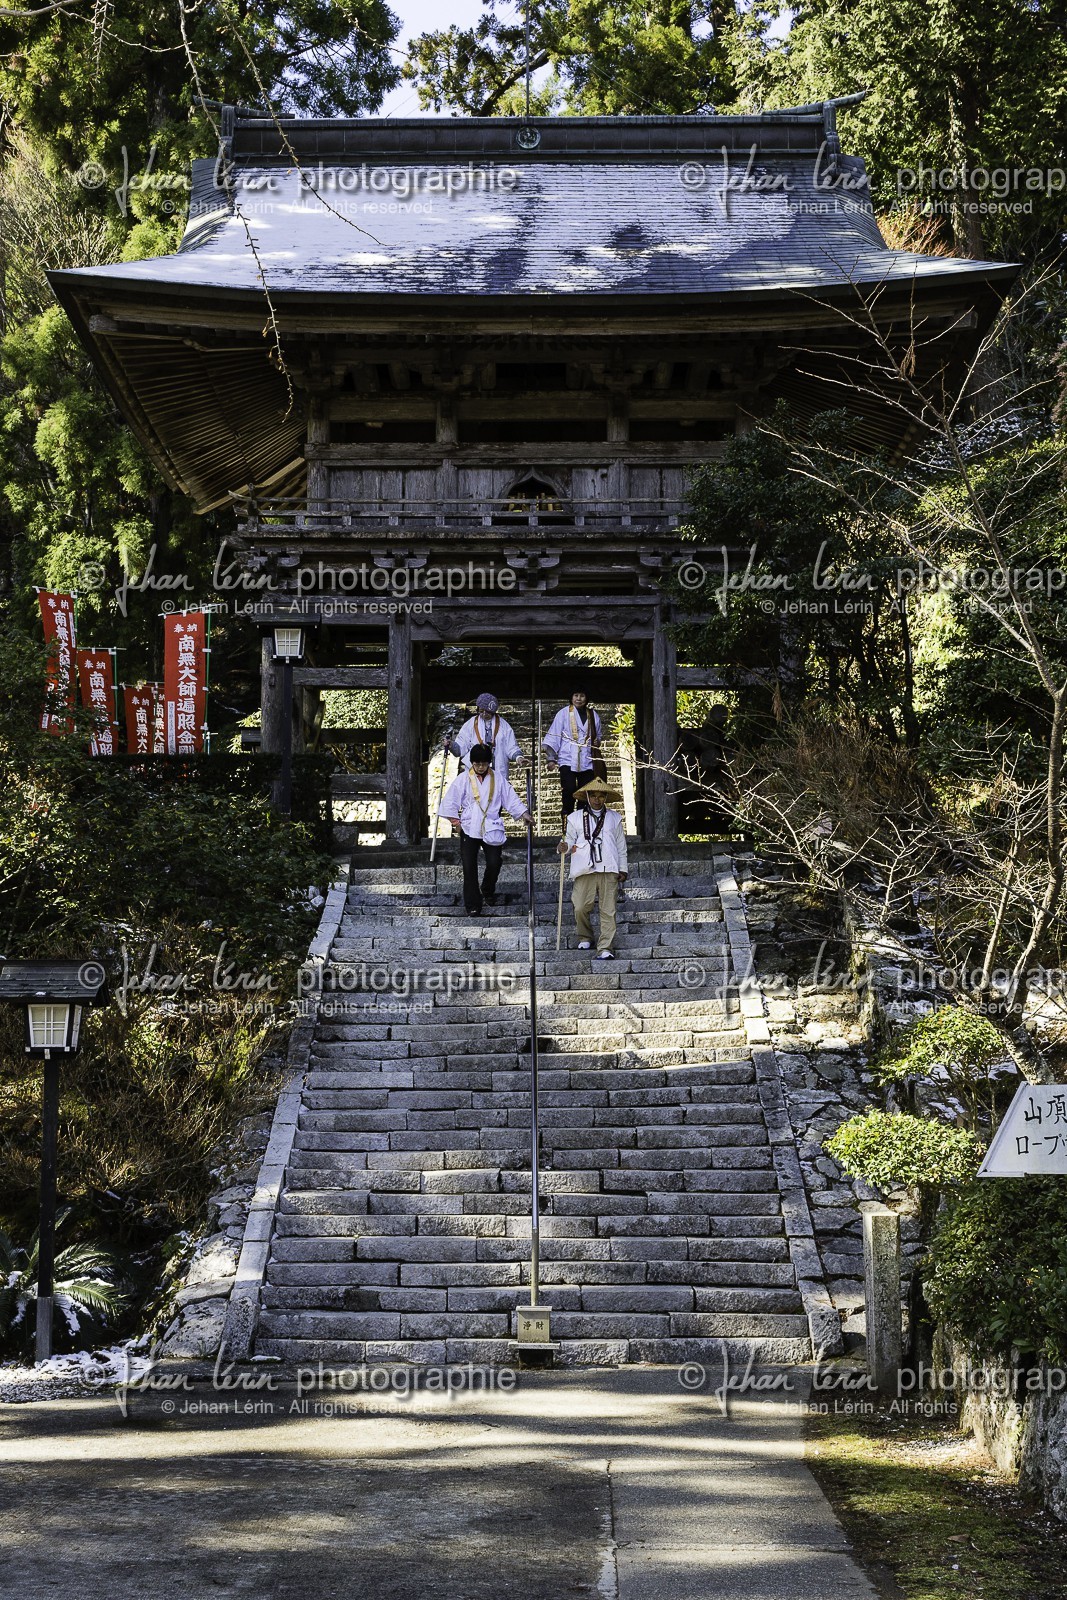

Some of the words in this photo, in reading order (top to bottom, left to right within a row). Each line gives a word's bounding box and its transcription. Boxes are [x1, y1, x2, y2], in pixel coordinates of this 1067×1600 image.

[173, 624, 198, 633] 奉納
[84, 659, 106, 669] 奉納
[135, 707, 149, 754] 南無大
[1024, 1094, 1067, 1124] 山頂
